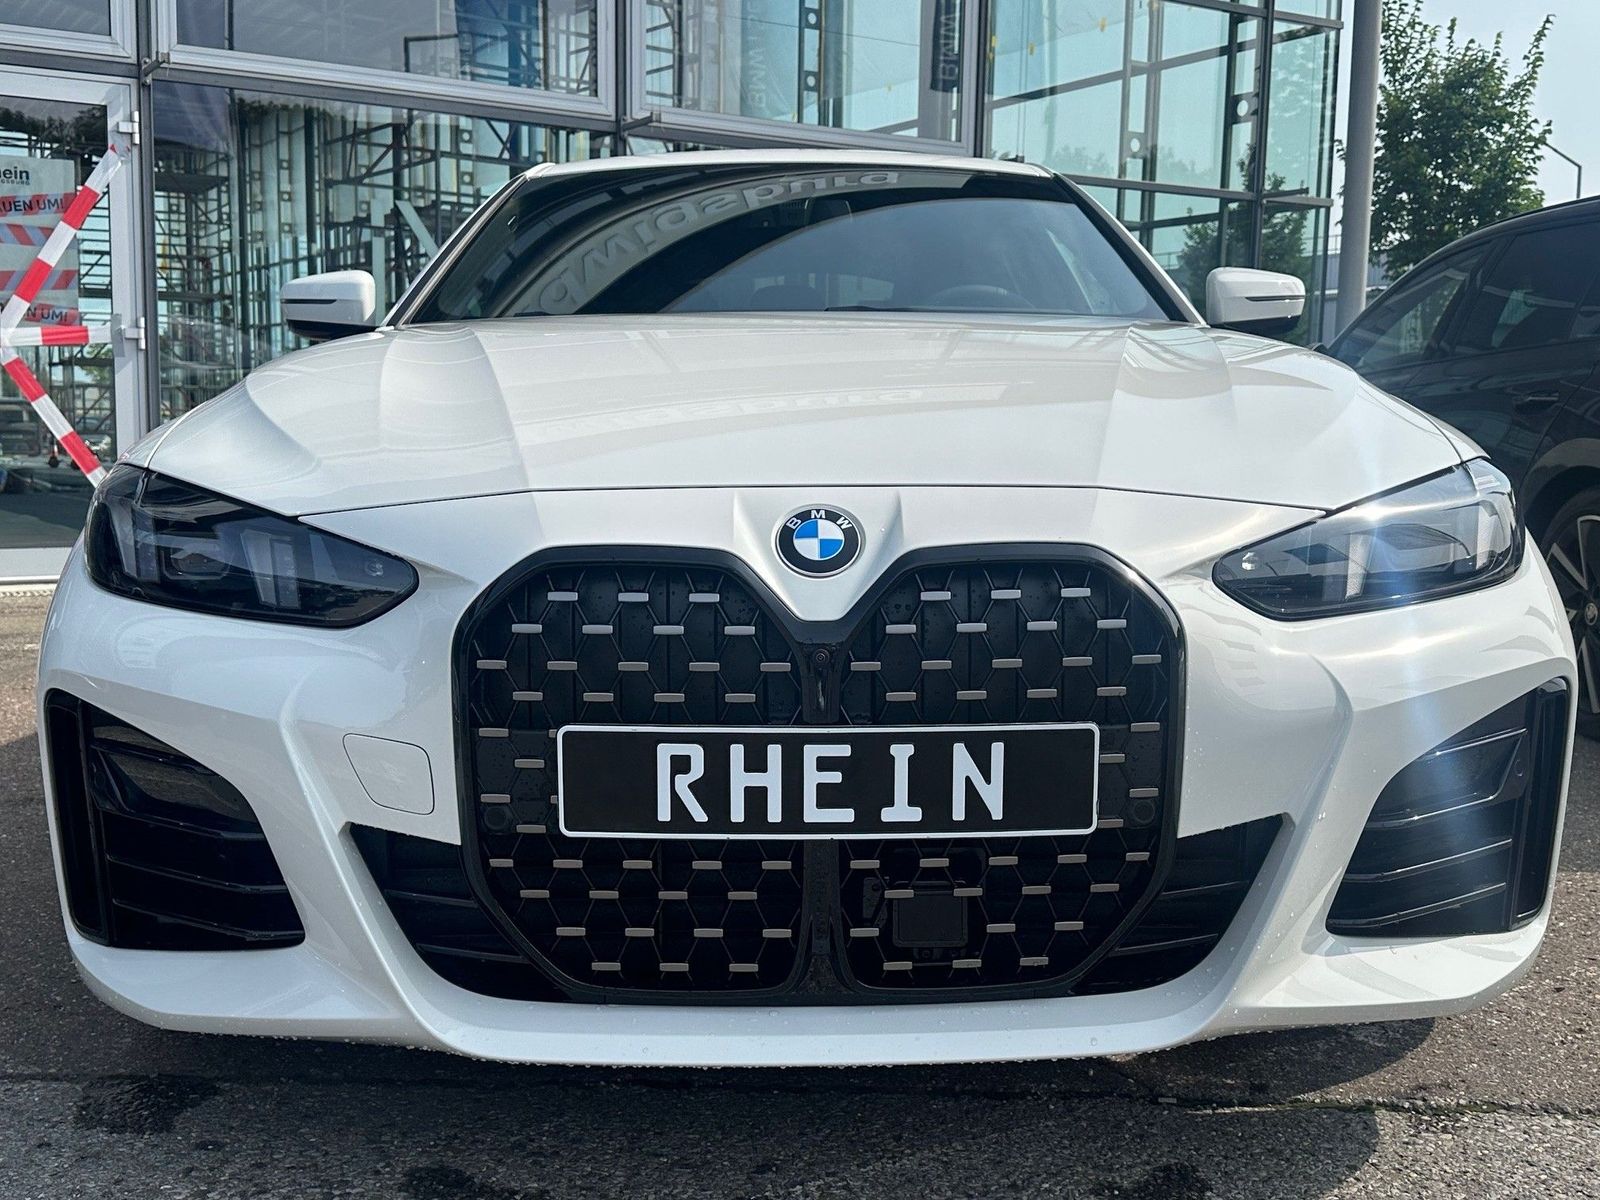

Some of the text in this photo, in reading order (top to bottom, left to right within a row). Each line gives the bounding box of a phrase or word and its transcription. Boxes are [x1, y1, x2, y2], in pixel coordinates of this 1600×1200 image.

[0, 166, 30, 181] ein
[785, 509, 853, 530] BMW
[656, 742, 1005, 823] RHEIN
